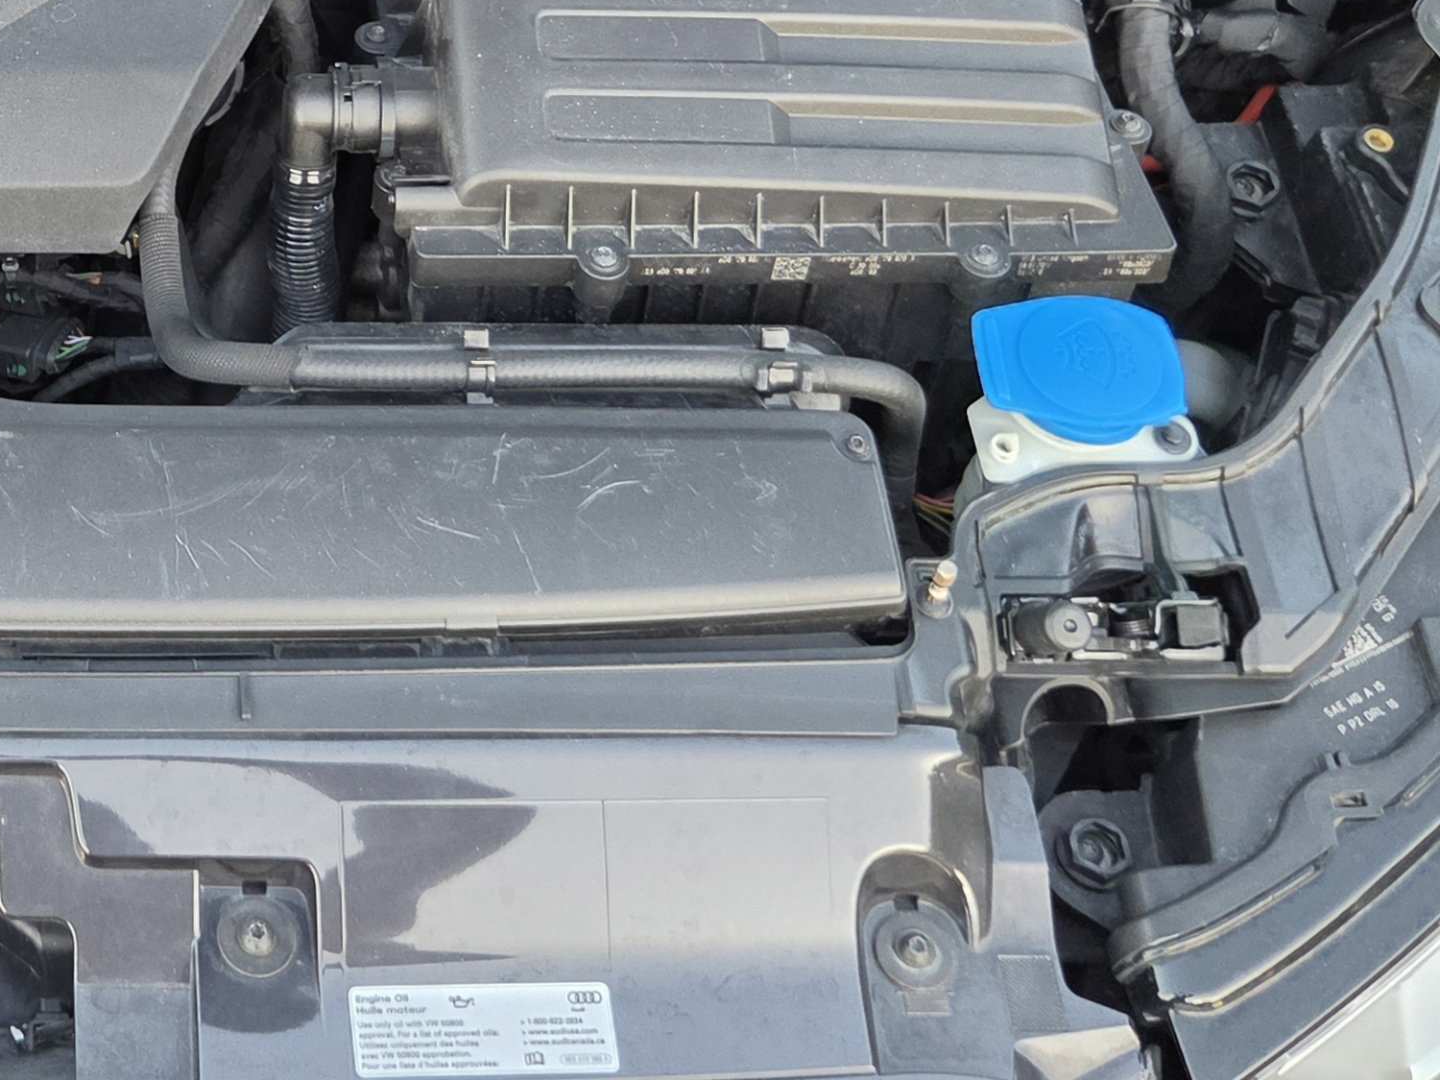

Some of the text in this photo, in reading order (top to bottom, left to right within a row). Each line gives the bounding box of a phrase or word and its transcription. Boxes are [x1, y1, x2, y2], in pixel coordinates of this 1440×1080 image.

[1323, 700, 1347, 718] SAE
[1363, 687, 1374, 699] A
[1337, 723, 1346, 735] P
[1347, 716, 1364, 730] P2
[355, 993, 409, 1005] Engine Oil
[356, 1006, 427, 1014] Huile moteur
[424, 1019, 439, 1027] VW
